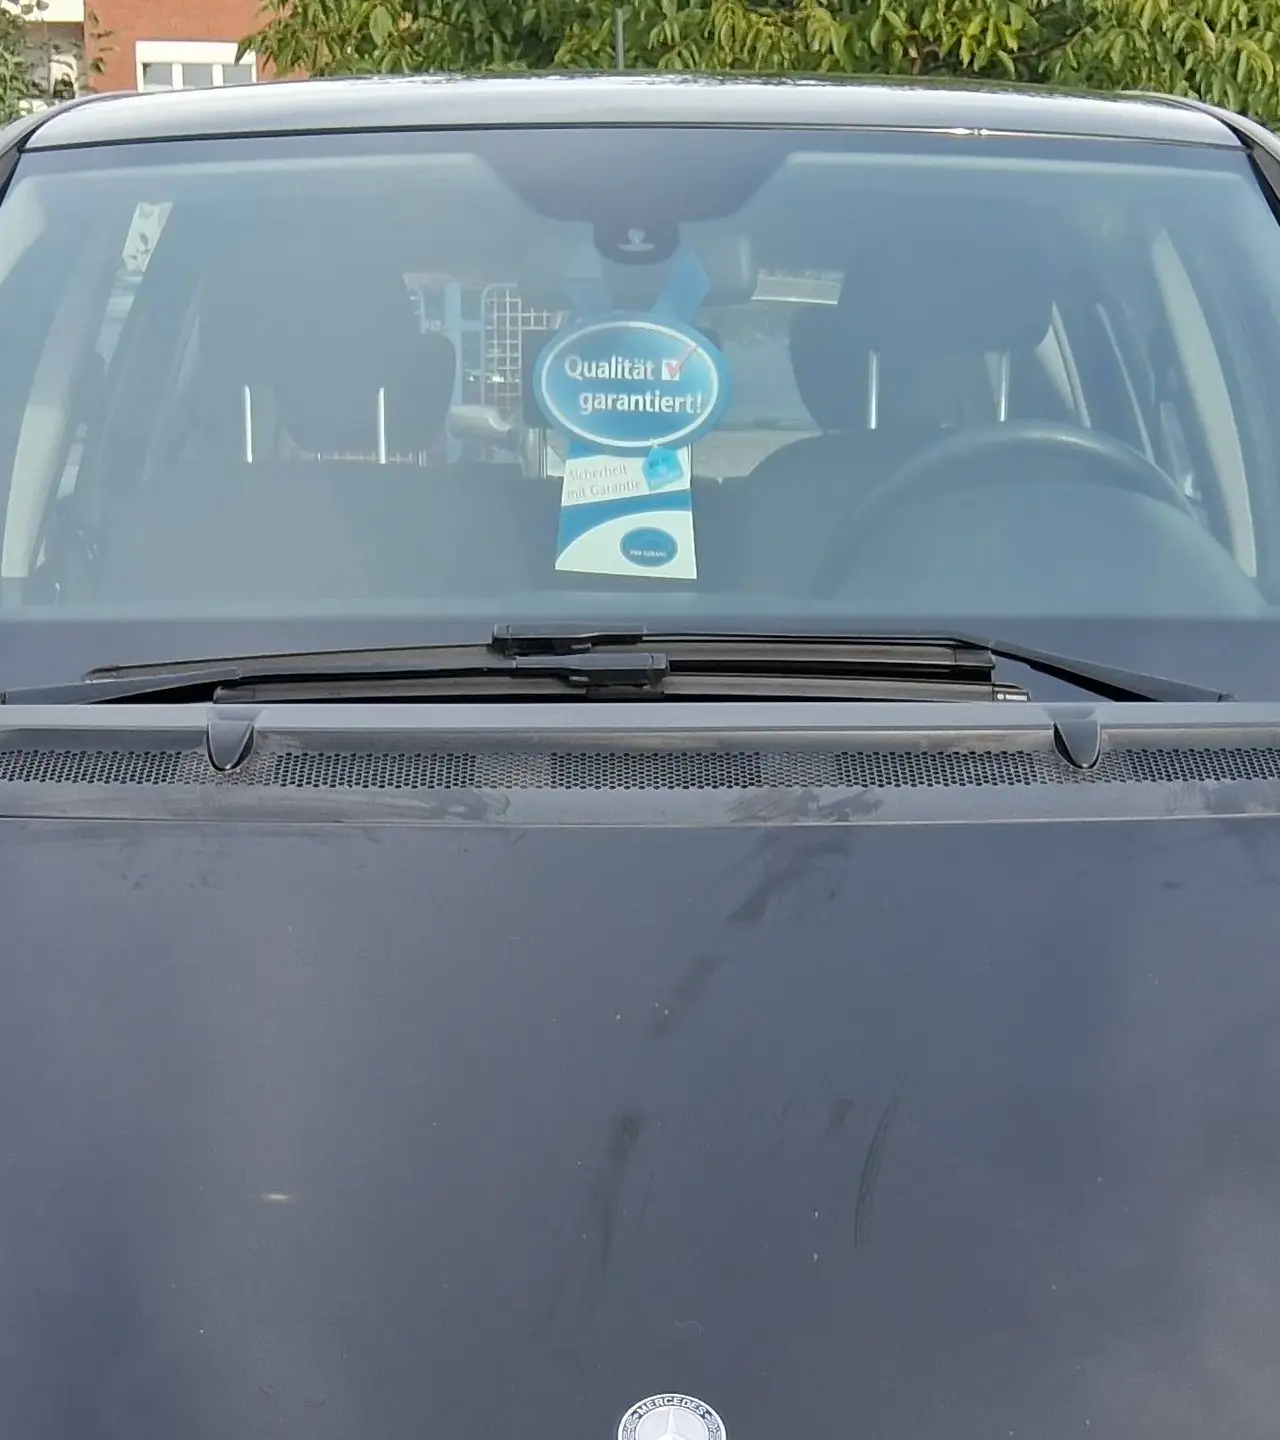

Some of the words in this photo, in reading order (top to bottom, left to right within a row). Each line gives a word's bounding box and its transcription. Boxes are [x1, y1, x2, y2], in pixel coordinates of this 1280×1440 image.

[564, 353, 655, 381] Qualität
[579, 389, 702, 415] garantiert!
[568, 462, 627, 481] Sicherheit
[567, 484, 587, 499] mit
[590, 480, 641, 496] Garantie
[637, 1396, 707, 1416] MERCEDES
